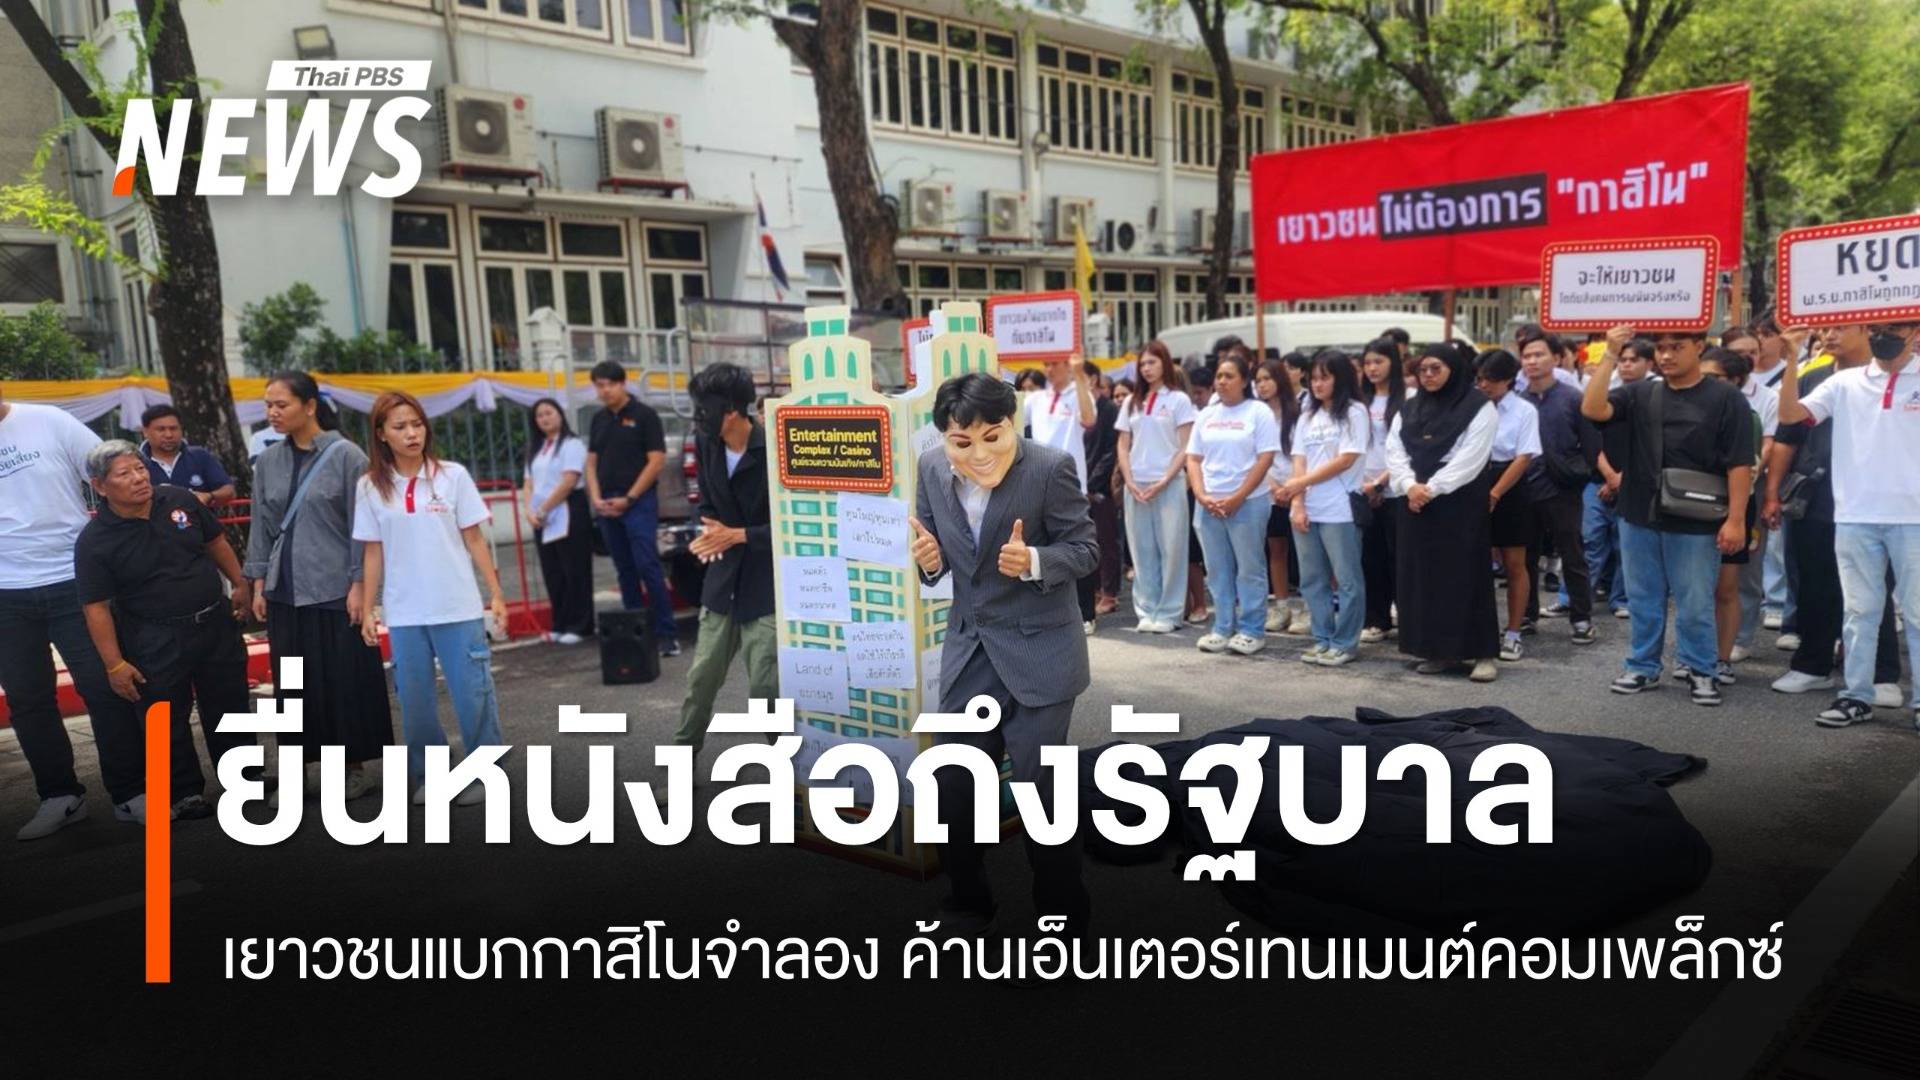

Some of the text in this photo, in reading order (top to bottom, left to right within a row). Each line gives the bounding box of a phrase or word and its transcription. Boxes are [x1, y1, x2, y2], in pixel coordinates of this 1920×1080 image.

[1278, 161, 1709, 244] เยาวชน ไม่ต้องการ "กาสิโน"
[1837, 233, 1920, 282] หยุด
[1577, 264, 1676, 286] จะให้เยาวชน
[789, 427, 878, 443] Entertainment
[793, 444, 831, 457] Complex
[840, 445, 872, 456] Casino
[795, 662, 822, 675] Land
